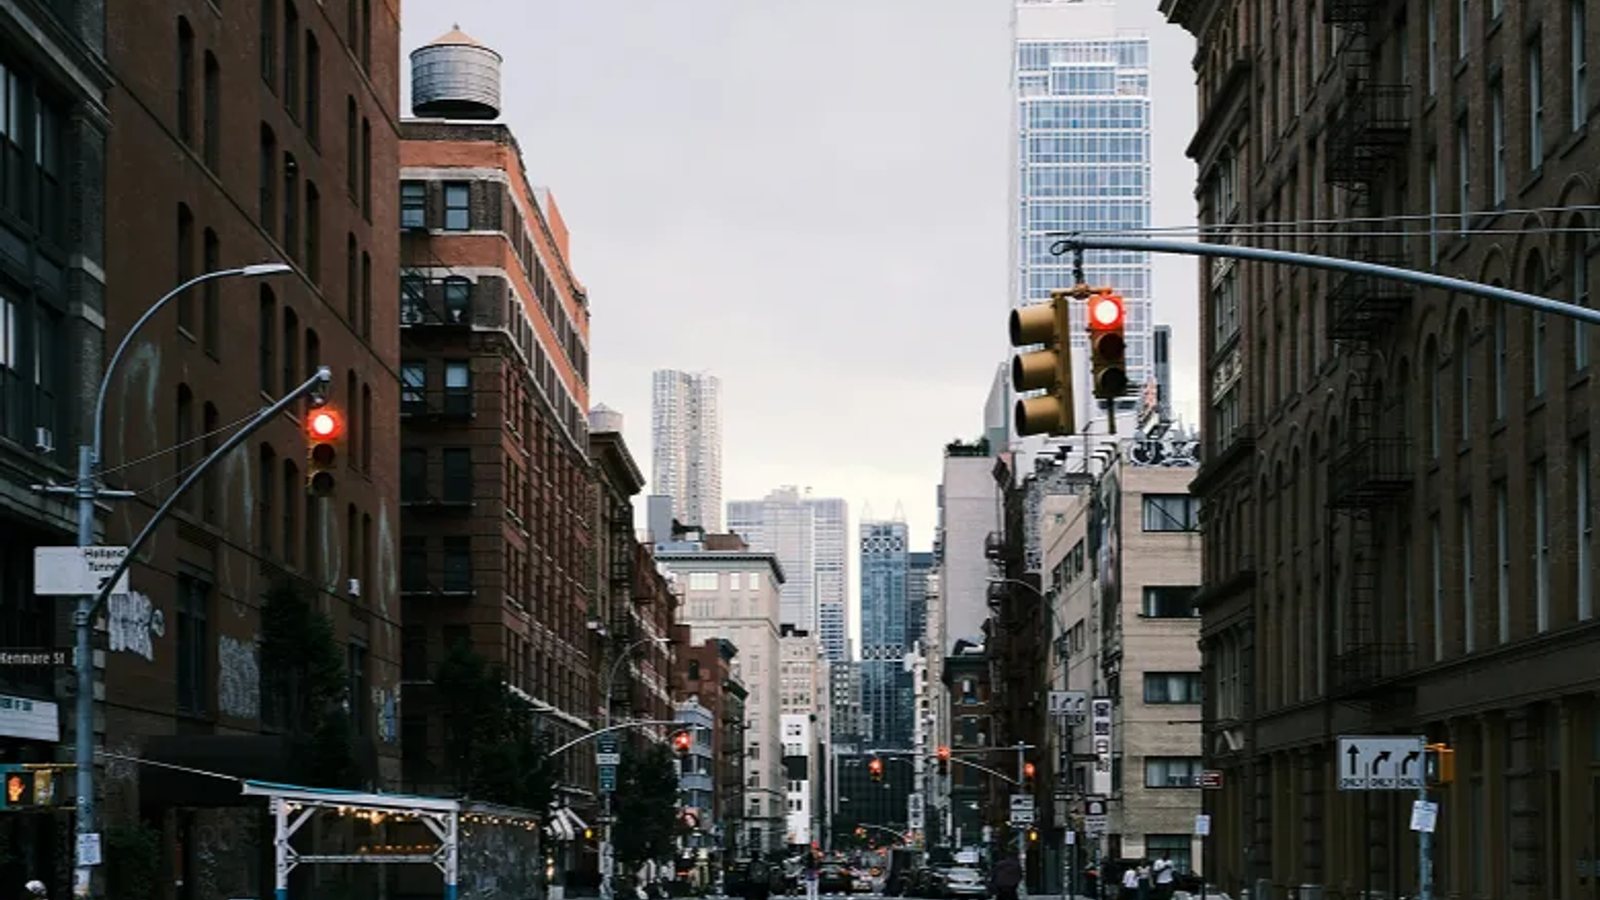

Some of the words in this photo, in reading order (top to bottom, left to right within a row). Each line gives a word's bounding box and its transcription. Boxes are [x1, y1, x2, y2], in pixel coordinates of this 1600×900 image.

[84, 548, 125, 558] Holland
[88, 561, 120, 571] Tunne
[0, 652, 50, 664] Kenmare
[53, 652, 65, 664] St
[1343, 778, 1365, 787] ONLY
[1371, 778, 1394, 787] ONLY
